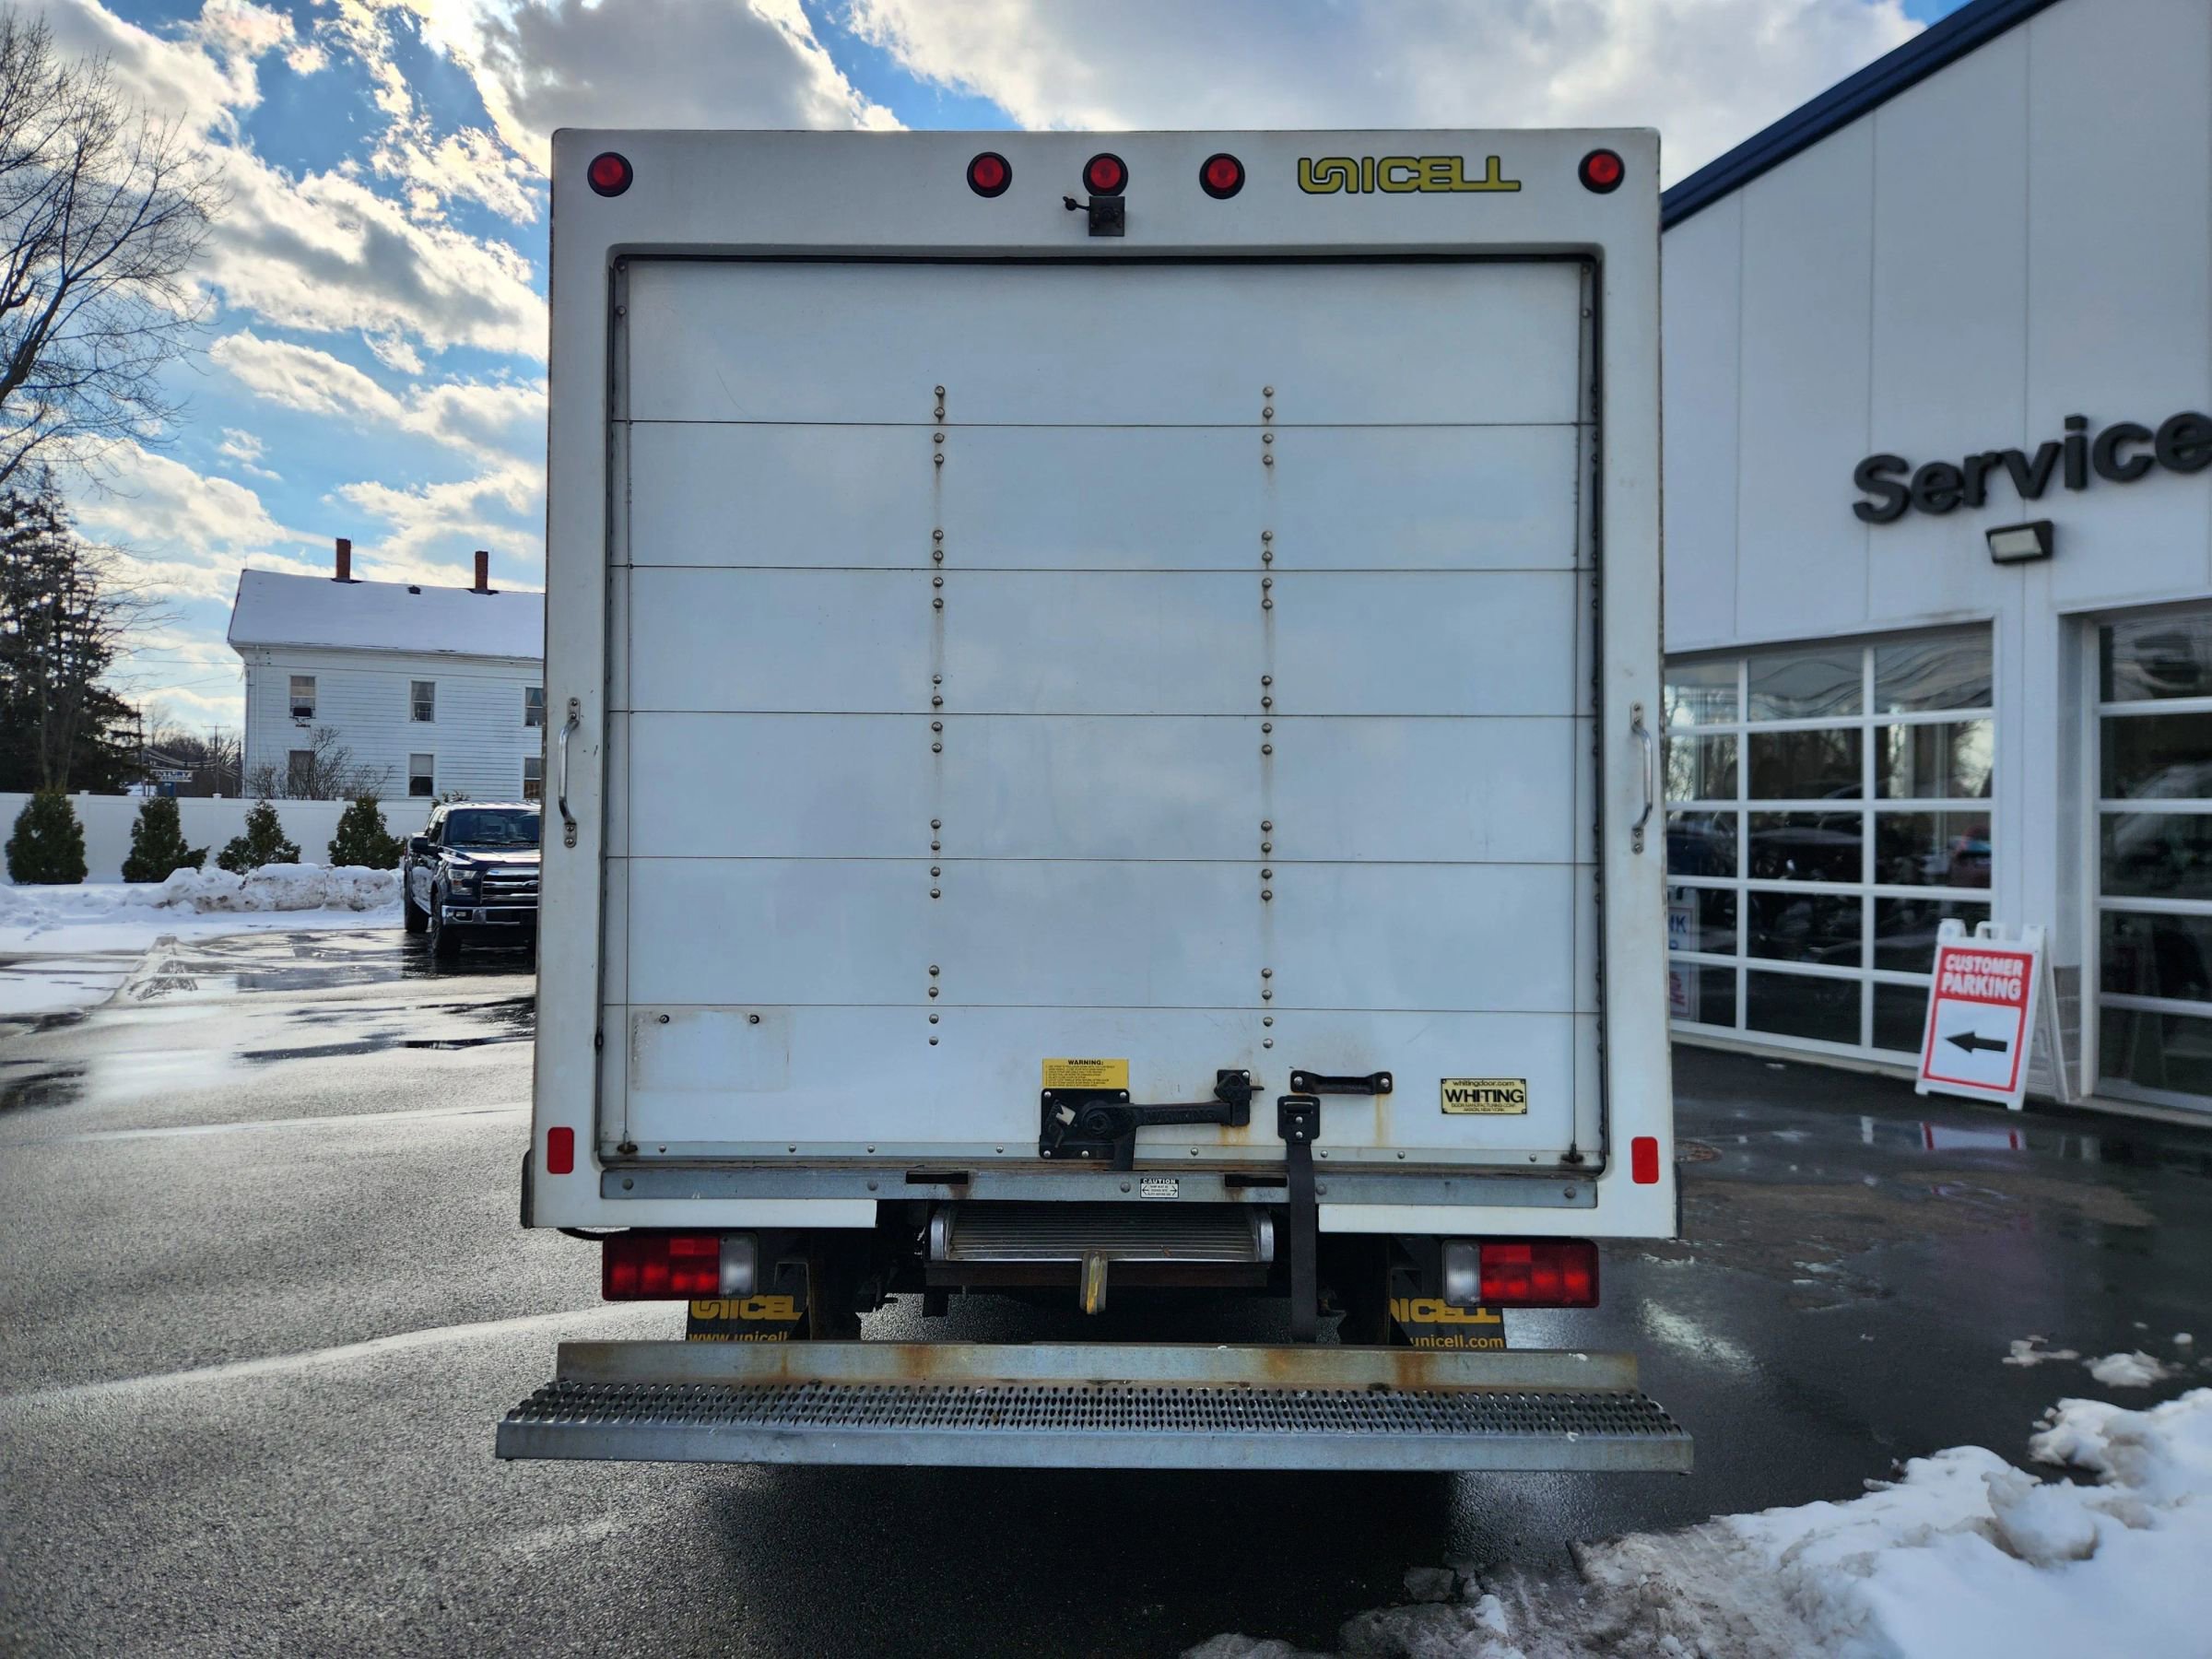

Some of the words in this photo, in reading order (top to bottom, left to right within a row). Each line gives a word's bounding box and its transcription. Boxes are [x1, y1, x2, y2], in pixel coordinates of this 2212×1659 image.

[1298, 156, 1522, 194] UNICELL
[1853, 411, 2212, 524] Service
[1945, 953, 2024, 978] CUSTOMER
[1941, 971, 2022, 1001] PARKING
[1444, 1088, 1524, 1103] WHITING
[691, 1295, 803, 1320] UNICEL
